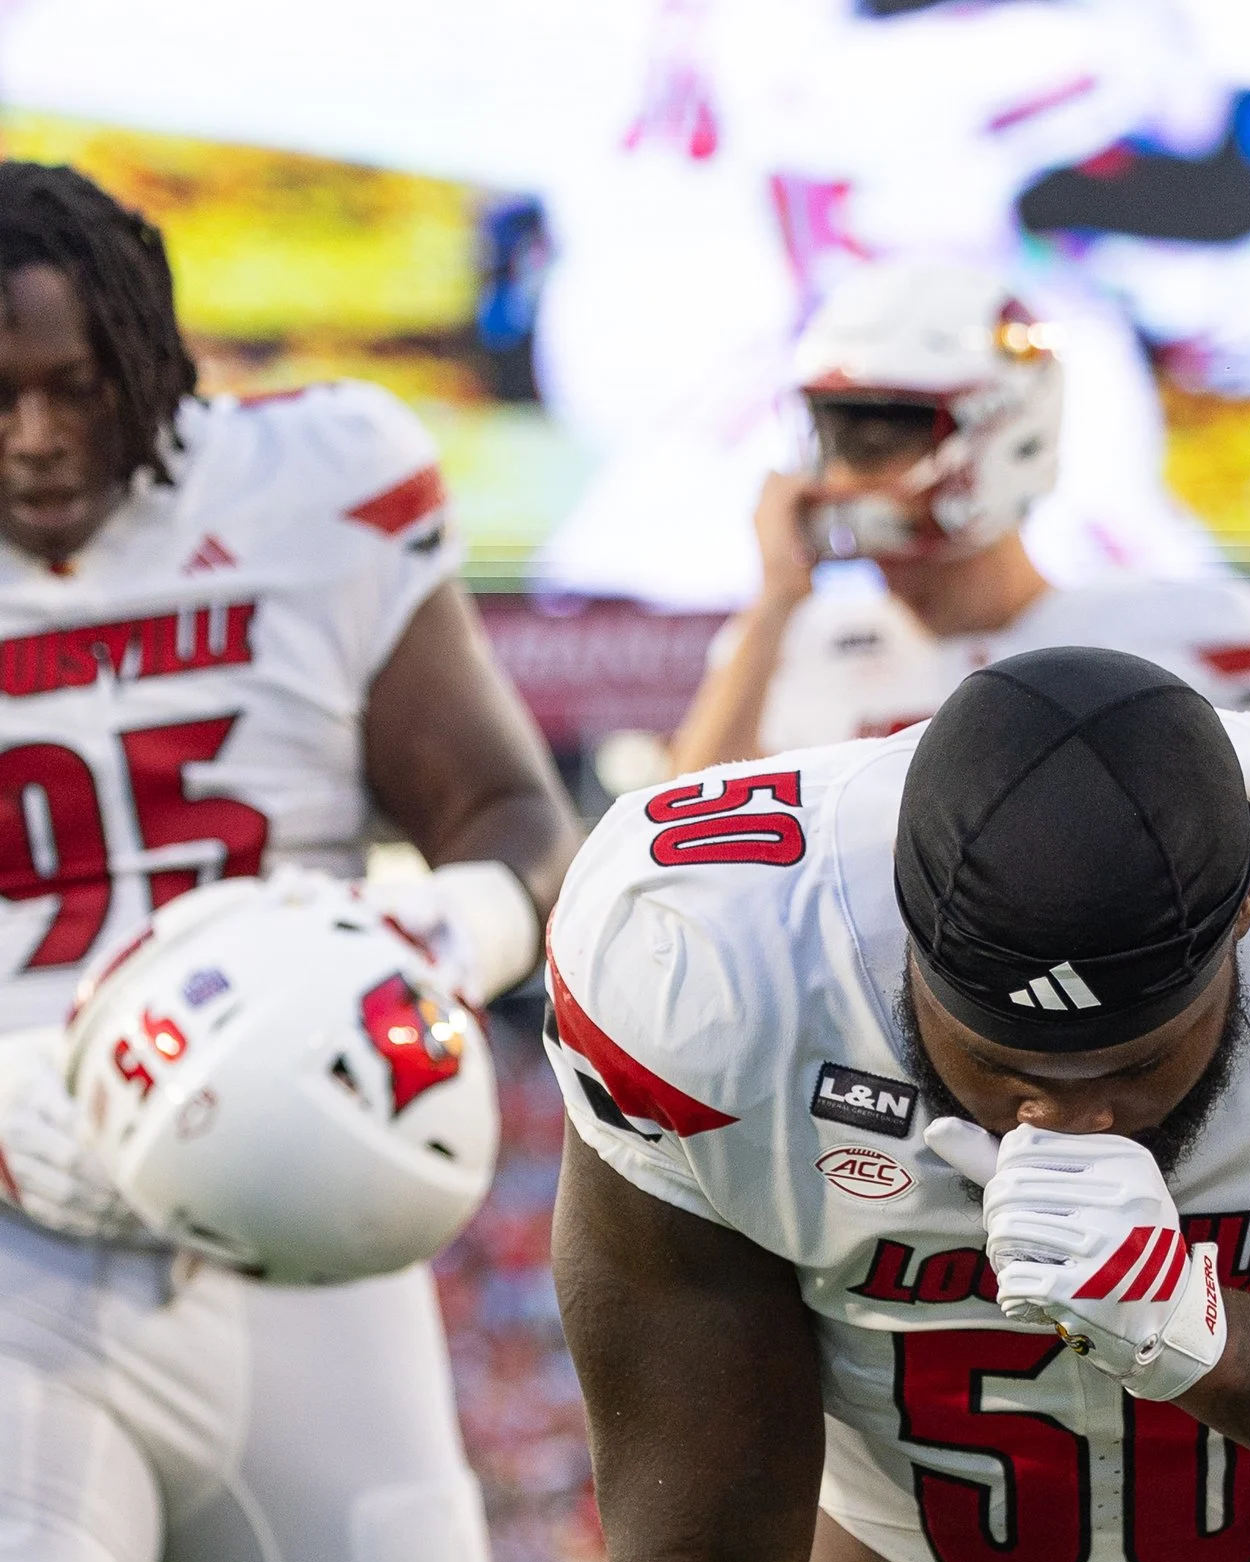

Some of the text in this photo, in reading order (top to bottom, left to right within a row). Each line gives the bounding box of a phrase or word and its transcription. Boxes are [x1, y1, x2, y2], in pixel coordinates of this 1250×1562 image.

[0, 711, 269, 974] 95
[645, 769, 807, 868] 50
[819, 1076, 910, 1119] L&N
[831, 1159, 898, 1182] ACC
[1203, 1254, 1218, 1336] ADIZERO
